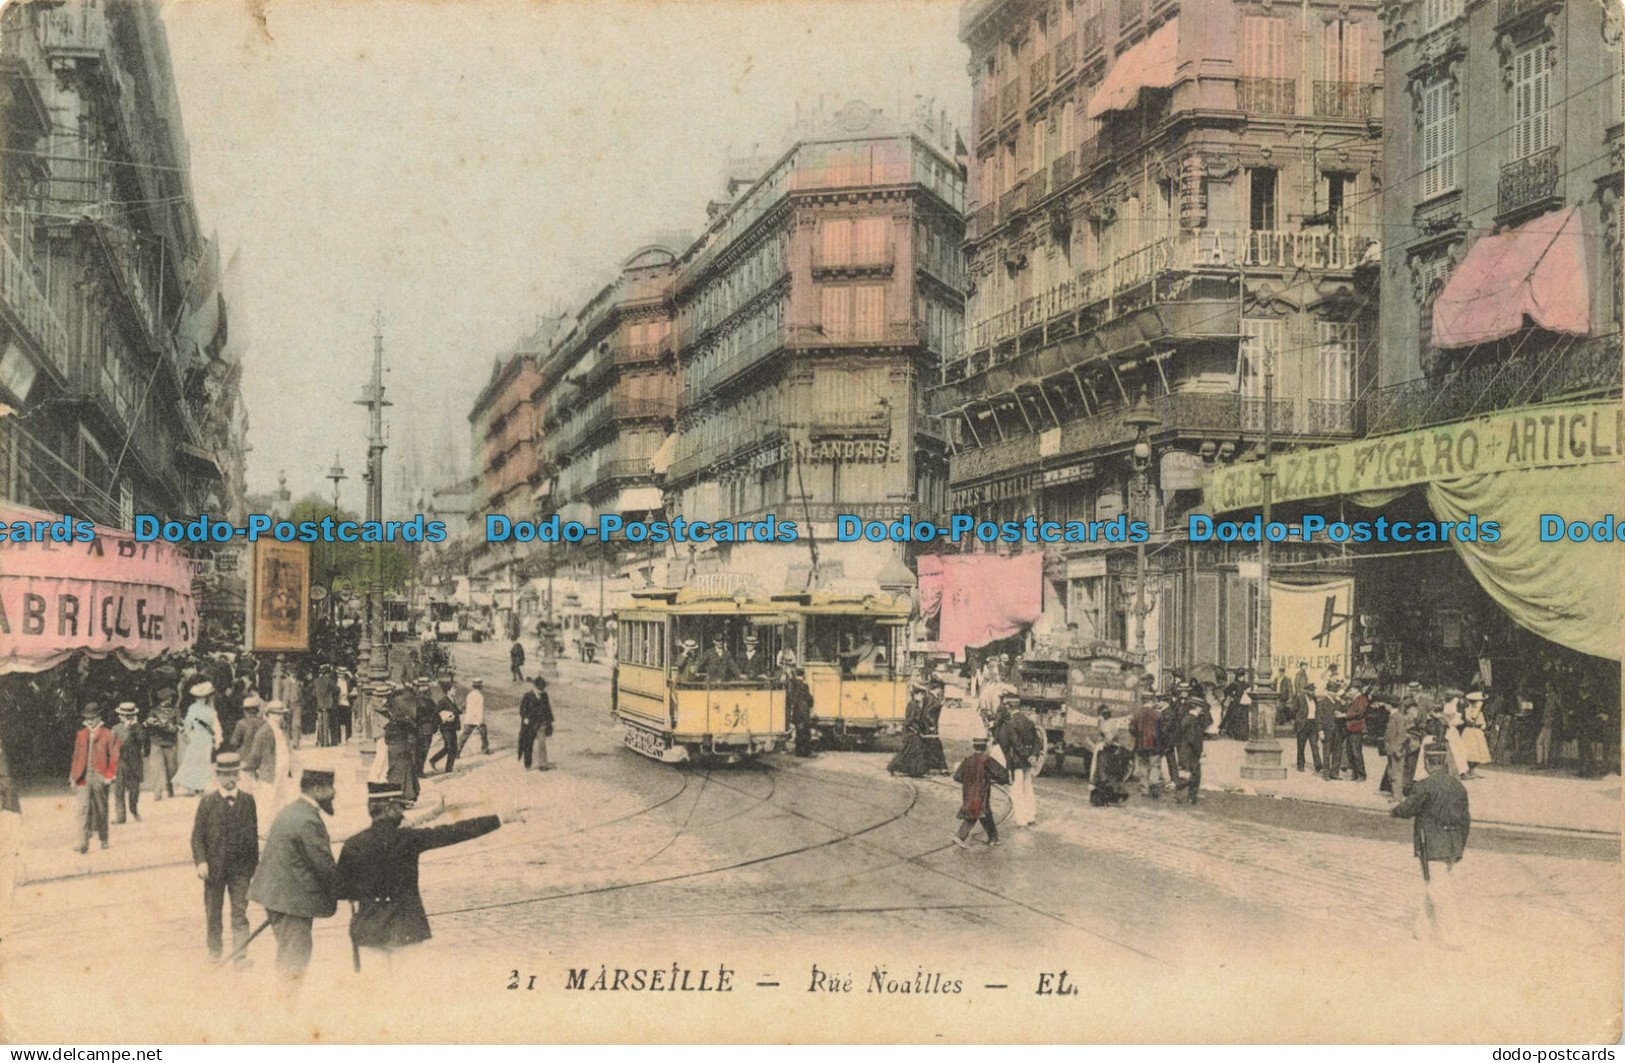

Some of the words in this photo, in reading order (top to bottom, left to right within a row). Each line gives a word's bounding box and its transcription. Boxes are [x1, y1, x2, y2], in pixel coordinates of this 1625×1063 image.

[1235, 229, 1358, 270] MUTUELL
[1350, 428, 1479, 489] FIGARO
[1272, 653, 1343, 669] HAPELLERIE
